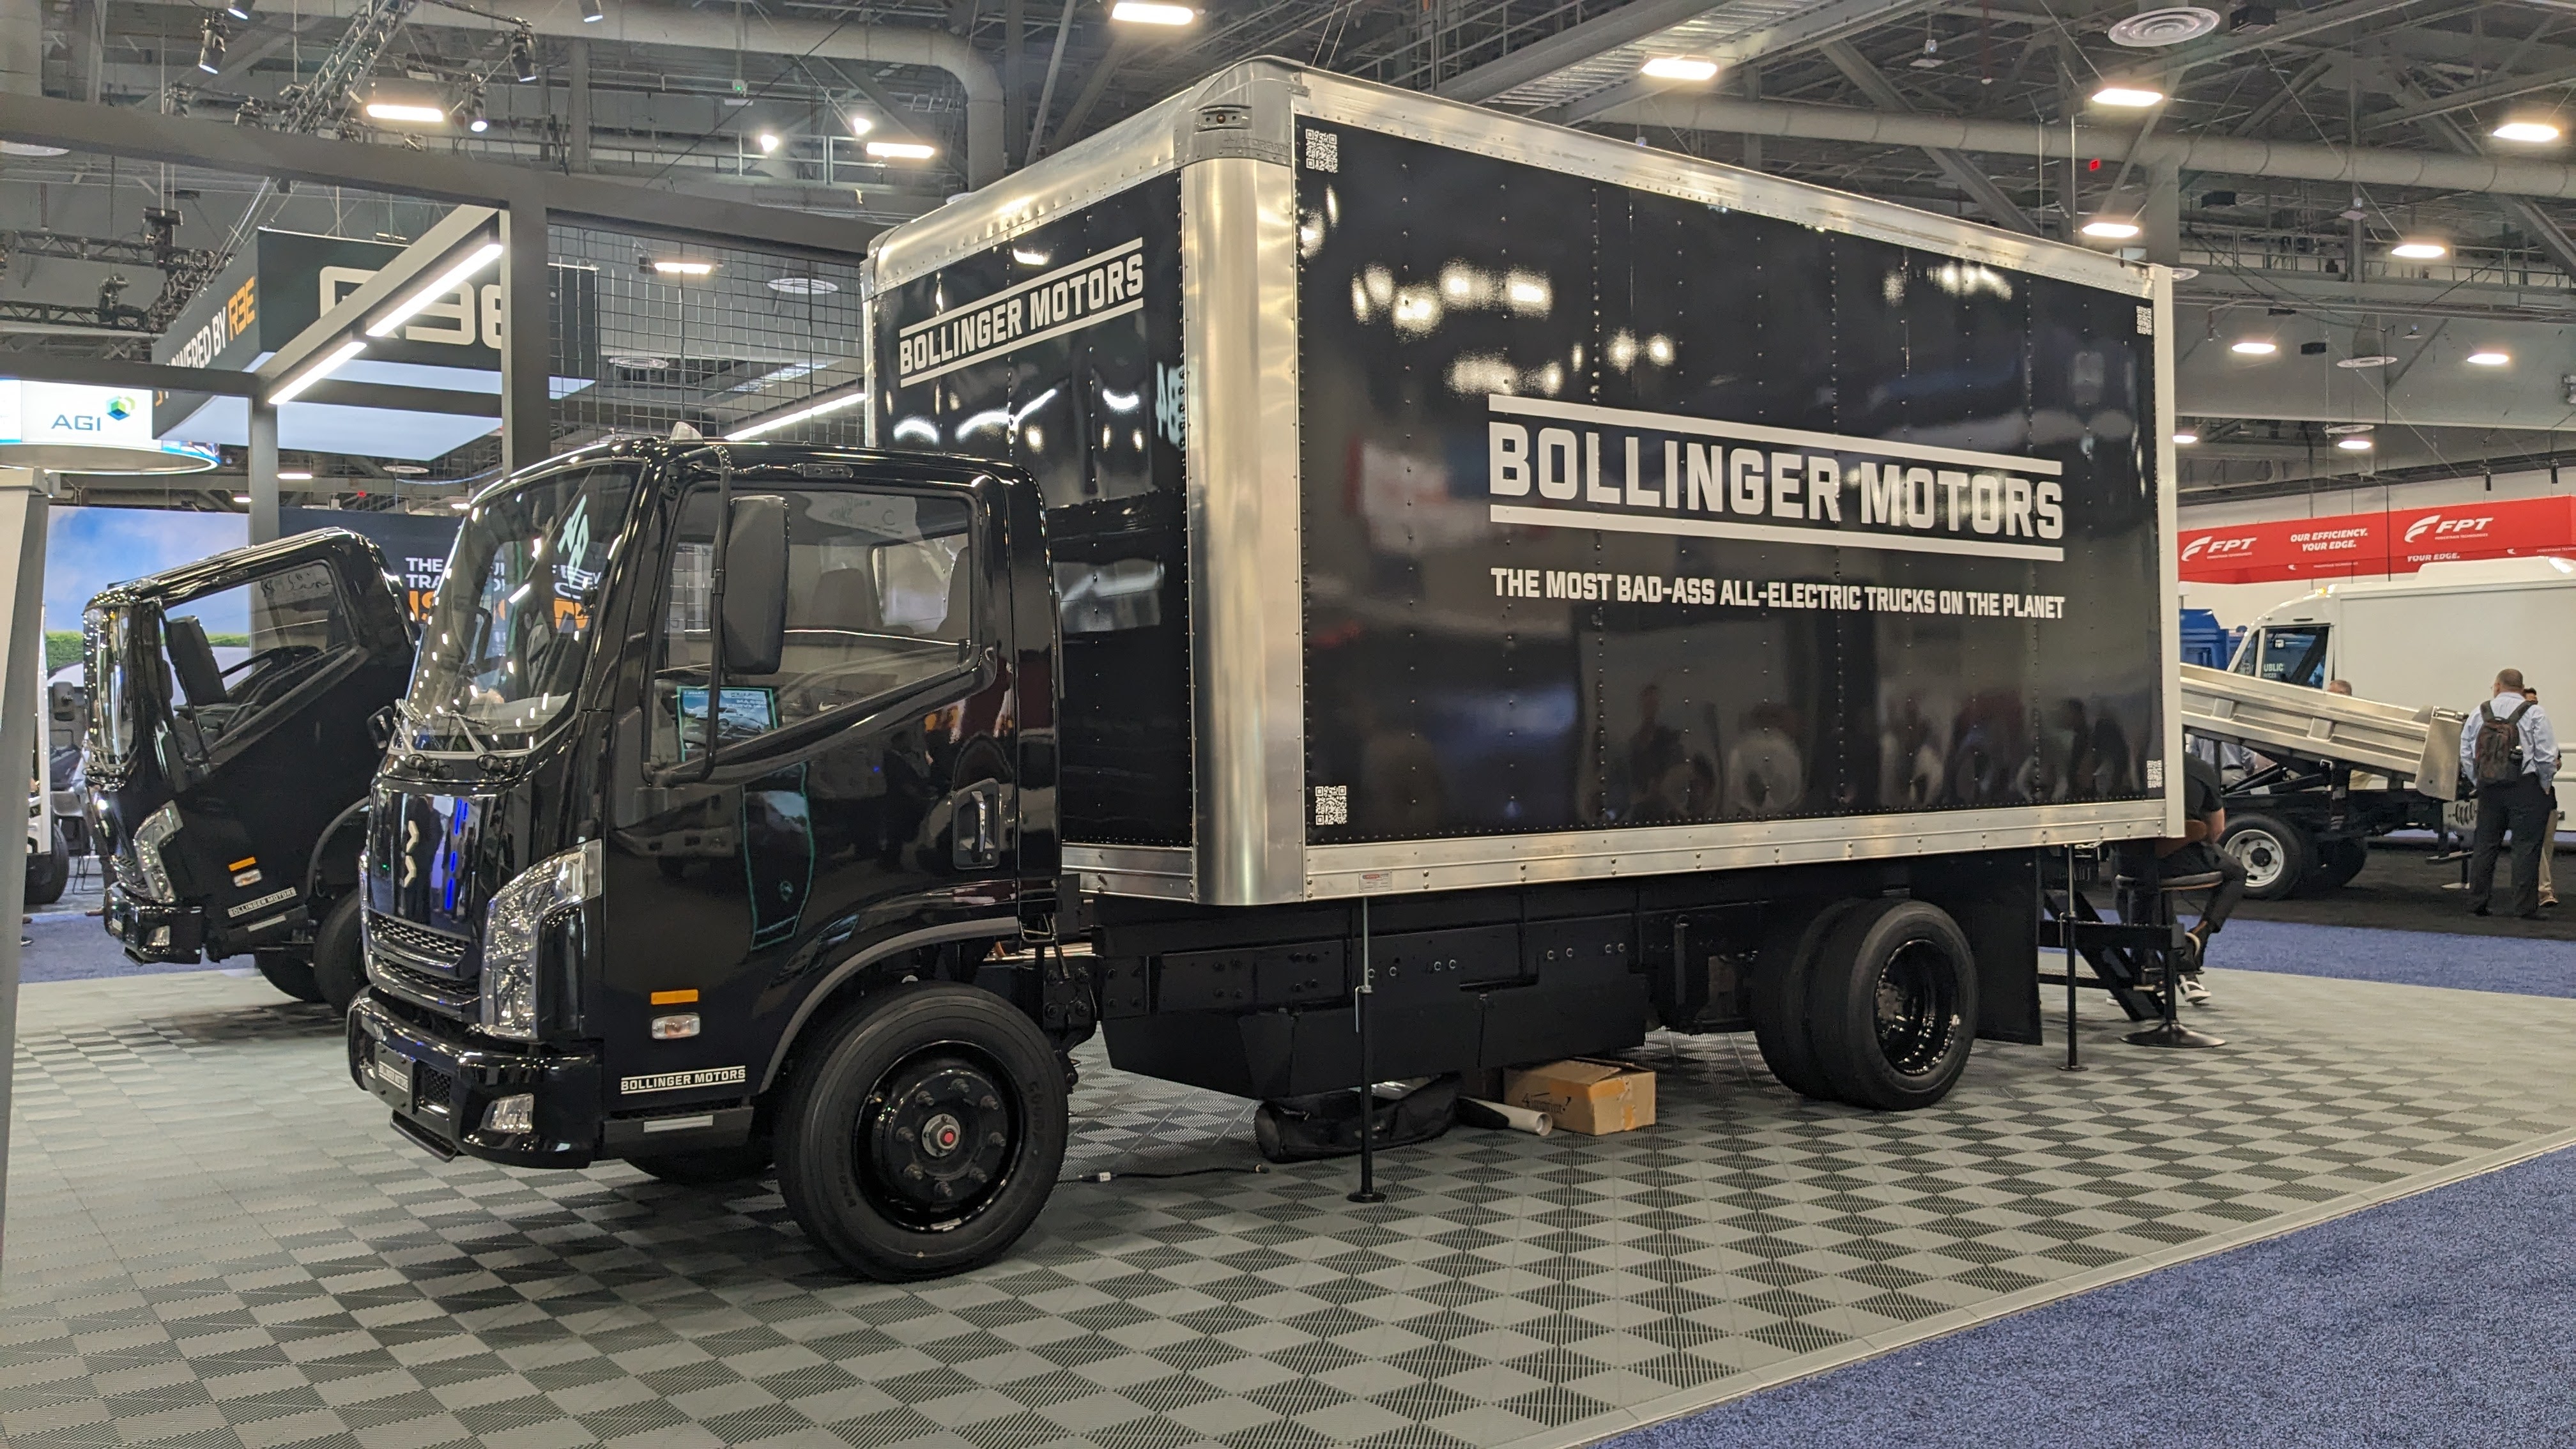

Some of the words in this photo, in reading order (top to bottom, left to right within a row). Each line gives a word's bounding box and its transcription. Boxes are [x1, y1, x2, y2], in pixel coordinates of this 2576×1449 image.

[900, 298, 1022, 376] BOLLINGER
[1029, 253, 1144, 330] MOTORS
[211, 306, 227, 356] BY
[50, 414, 101, 431] AGI
[1488, 421, 1842, 522] BOLLINGER
[1860, 461, 2064, 539] MOTORS
[2434, 517, 2494, 533] FPT
[2290, 533, 2310, 542] OUR
[2311, 528, 2368, 540] EFFICIENCY.
[2207, 537, 2257, 553] FPT
[2302, 542, 2327, 551] YOUR
[2329, 539, 2357, 549] EDGE.
[404, 557, 444, 572] THE
[2407, 553, 2432, 562] YOUR
[2433, 552, 2460, 560] EDGE.
[1491, 567, 1540, 597] THE
[1546, 571, 1612, 601] MOST
[1616, 574, 1715, 604] BAD-ASS
[1719, 579, 1862, 611] ALL-ELECTRIC
[1864, 586, 1936, 613] TRUCKS
[1939, 590, 1963, 615] ON
[1966, 592, 2000, 617] THE
[2003, 594, 2066, 618] PLANET
[620, 1075, 691, 1091] BOLLINGER
[694, 1069, 746, 1084] MOTORS
